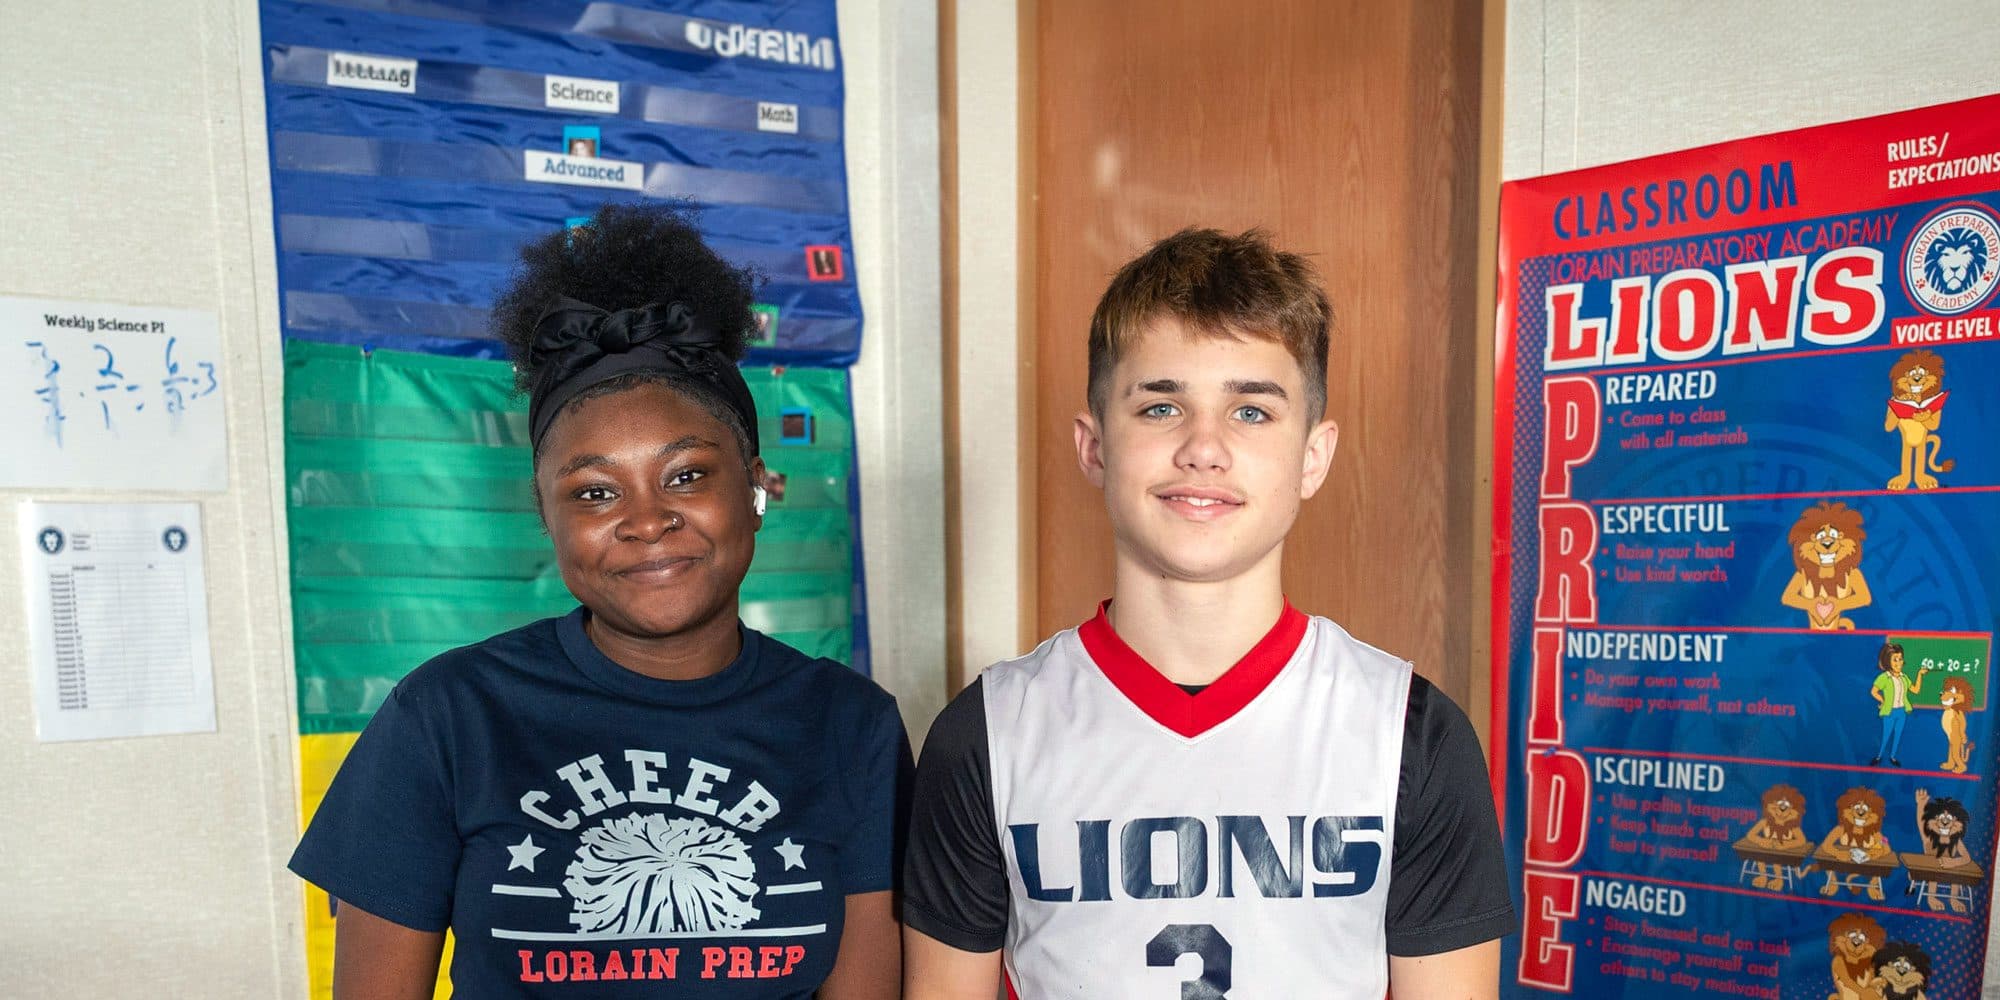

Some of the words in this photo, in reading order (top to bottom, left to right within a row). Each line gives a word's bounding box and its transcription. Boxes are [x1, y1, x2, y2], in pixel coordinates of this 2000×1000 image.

[551, 82, 614, 104] Science
[1887, 132, 1950, 162] RULES/
[544, 157, 625, 182] Advanced
[1888, 152, 2000, 189] EXPECTATIONS
[1553, 161, 1799, 240] CLASSROOM
[1550, 253, 1625, 284] LORAIN
[1630, 232, 1772, 275] PREPARATORY
[1779, 212, 1899, 257] ACADEMY
[1913, 227, 1939, 270] LORAIN
[1940, 215, 1998, 262] PREPARATORY
[1544, 246, 1885, 371] LIONS
[1929, 287, 1980, 309] ACADEMY
[44, 314, 95, 332] Weekly
[98, 318, 148, 333] Science
[1896, 320, 1942, 344] VOICE
[1947, 317, 1993, 339] LEVEL
[1606, 370, 1717, 405] REPARED
[1620, 410, 1664, 427] Come
[1669, 410, 1685, 424] to
[1690, 406, 1726, 423] class
[1620, 432, 1649, 449] with
[1654, 430, 1674, 448] all
[1678, 426, 1748, 447] materials
[1603, 503, 1730, 534] ESPECTFUL
[1616, 543, 1653, 559] Raise
[1658, 547, 1691, 564] your
[1695, 541, 1735, 559] hand
[1616, 565, 1641, 582] Use
[1647, 565, 1676, 582] kind
[1680, 565, 1727, 582] words
[1567, 632, 1728, 662] NDEPENDENT
[1585, 669, 1604, 685] Do
[1609, 674, 1639, 688] your
[1645, 677, 1677, 688] own
[1683, 673, 1720, 688] work
[1948, 659, 1960, 671] 20
[1584, 693, 1643, 713] Manage
[1648, 694, 1712, 714] yourself,
[1718, 700, 1742, 713] not
[1746, 697, 1796, 716] others
[1595, 756, 1725, 792] ISCIPLINED
[519, 749, 781, 833] CHEER
[1612, 792, 1637, 809] Use
[1687, 799, 1757, 824] language
[1611, 815, 1646, 835] Keep
[1651, 817, 1694, 837] hands
[1700, 825, 1729, 841] and
[1007, 814, 1386, 902] LIONS
[1641, 841, 1655, 855] to
[1659, 845, 1718, 863] yourself
[1586, 879, 1686, 917] NGAGED
[1604, 915, 1637, 937] Stay
[1641, 919, 1698, 943] focused
[1702, 931, 1730, 948] and
[1734, 939, 1753, 951] on
[1759, 939, 1791, 957] task
[518, 948, 680, 983] LORAIN
[700, 945, 806, 979] PREP
[1146, 923, 1233, 1000] 3
[1602, 937, 1681, 965] Encourage
[1686, 952, 1743, 971] yourself
[1747, 961, 1779, 977] and
[1600, 961, 1647, 980] others
[1652, 968, 1665, 982] to
[1670, 971, 1700, 991] stay
[1705, 977, 1780, 1000] motivated
